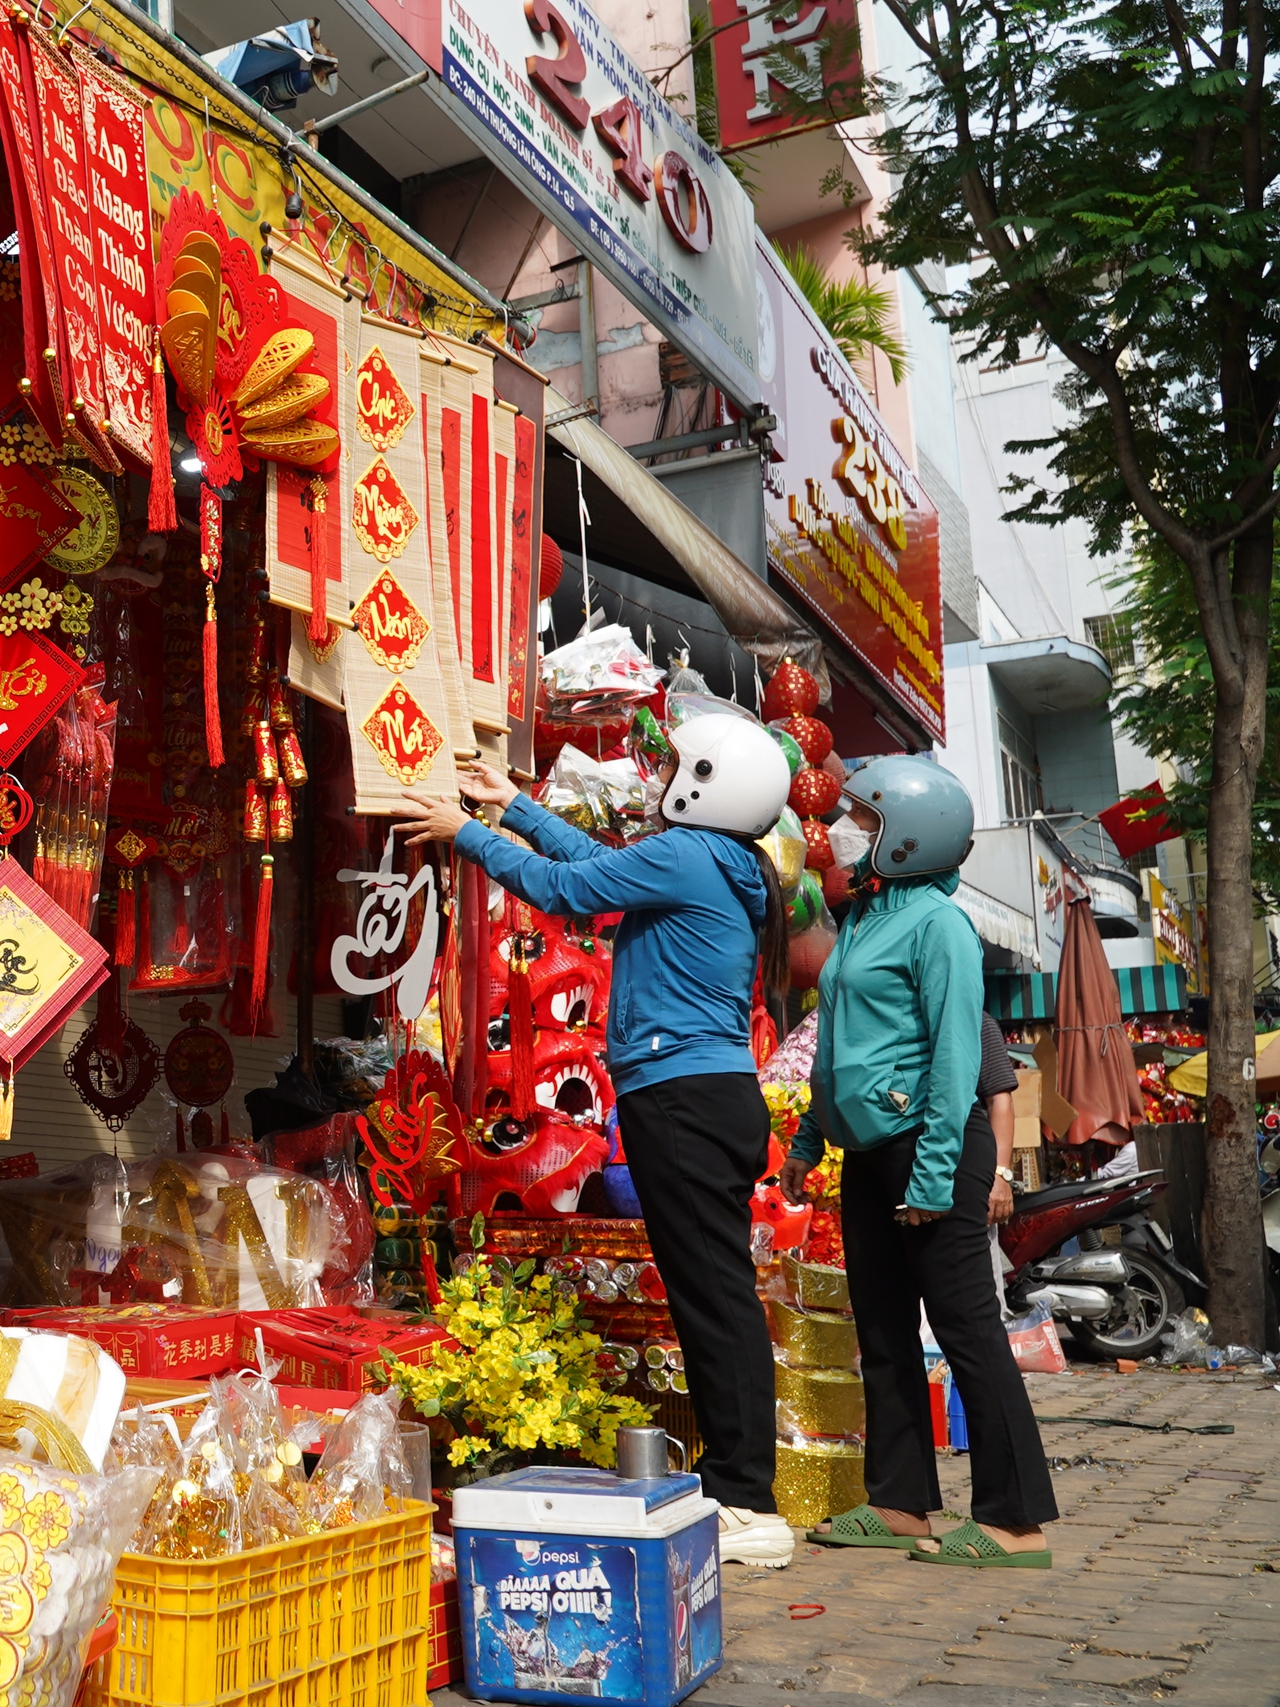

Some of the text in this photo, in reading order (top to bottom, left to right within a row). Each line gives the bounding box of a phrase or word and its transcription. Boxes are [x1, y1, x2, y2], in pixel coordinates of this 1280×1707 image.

[449, 0, 500, 70] CHUYÊN
[504, 59, 537, 112] KINH
[539, 100, 579, 159] DOANH
[572, 19, 594, 62] VĂN
[596, 49, 630, 101] PHÒNG
[579, 5, 600, 38] MTV
[610, 40, 625, 71] TM
[627, 61, 644, 92] HAI
[52, 109, 78, 164] Mã
[98, 126, 128, 178] An
[449, 24, 475, 72] DỤNG
[477, 58, 490, 92] CỤ
[492, 76, 512, 111] HỌC
[514, 101, 535, 137] SINH
[542, 131, 559, 165] VĂN
[561, 151, 590, 196] PHÒNG
[595, 189, 614, 222] GIẤY
[449, 65, 463, 93] ĐC:
[463, 81, 476, 107] 240
[476, 94, 489, 121] HẢI
[489, 107, 517, 149] THƯỢNG
[530, 150, 548, 182] ÔNG
[524, 0, 713, 254] 240
[53, 157, 88, 214] Đáo
[91, 167, 146, 250] Khang
[51, 195, 94, 266] Thàn
[97, 227, 146, 298] Thịnh
[64, 254, 98, 325] Côn
[100, 283, 153, 364] Vượng
[357, 370, 398, 428] Chúc
[817, 345, 845, 400] CỬA
[844, 377, 875, 446] HÀNG
[356, 483, 406, 544] Mừng
[837, 412, 908, 552] 238
[370, 593, 413, 642] Năm
[379, 708, 427, 758] Mới
[1242, 1057, 1255, 1081] 6
[542, 1551, 580, 1565] pepsi
[500, 1592, 548, 1612] PEPSI
